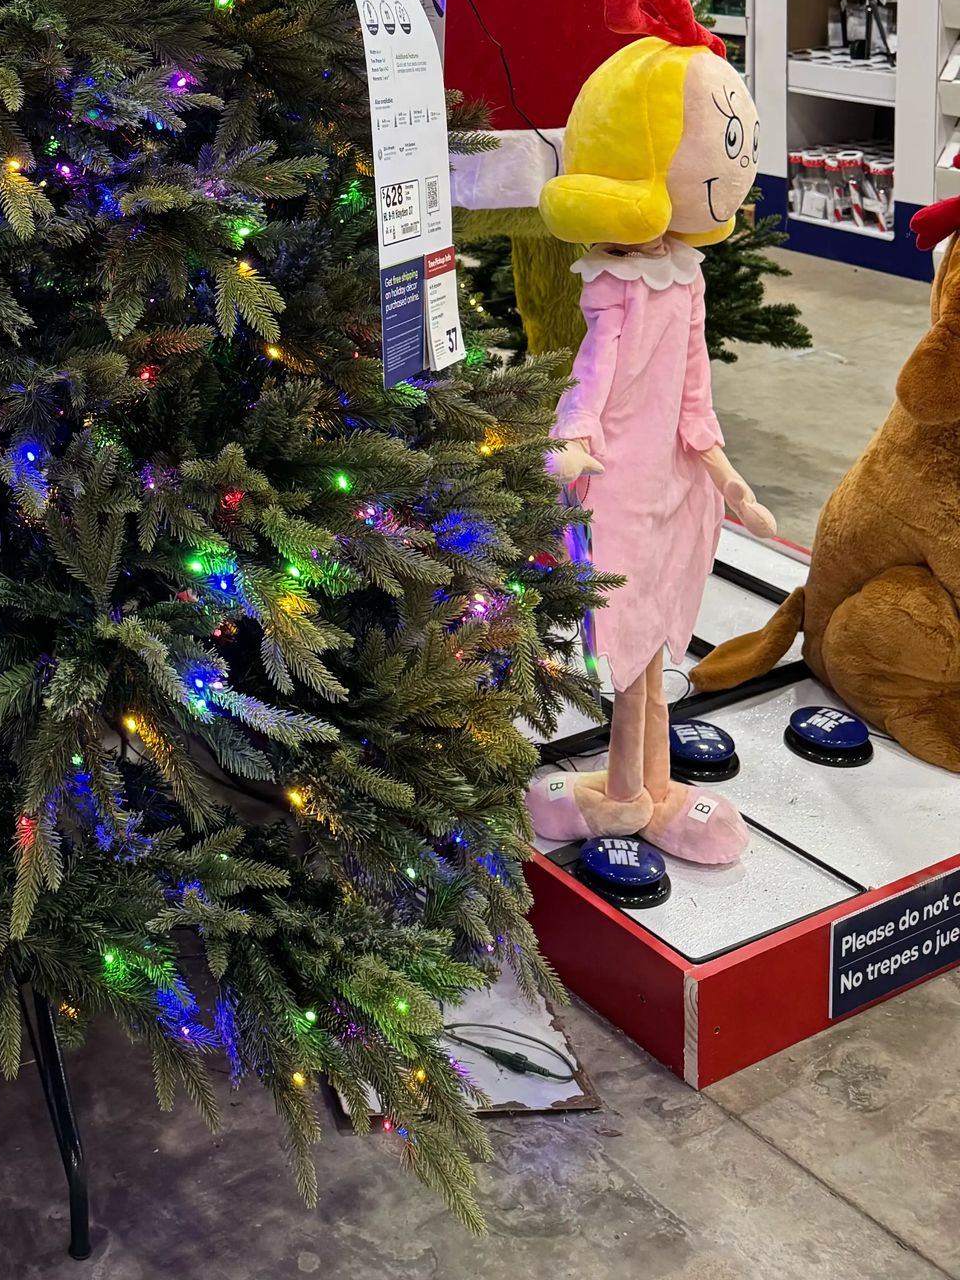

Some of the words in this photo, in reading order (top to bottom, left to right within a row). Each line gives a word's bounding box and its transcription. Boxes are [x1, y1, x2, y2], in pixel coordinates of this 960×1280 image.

[384, 277, 393, 288] Get
[392, 275, 401, 286] free
[401, 270, 418, 284] shipping
[391, 286, 405, 299] holiday
[385, 297, 407, 314] purchased
[446, 327, 458, 353] 37
[806, 712, 840, 733] ME
[816, 707, 855, 723] TRY
[672, 723, 691, 745] TRY
[549, 781, 564, 793] B
[694, 802, 711, 814] B
[599, 838, 641, 851] TRY
[608, 850, 641, 867] ME
[842, 921, 895, 957] Please
[898, 909, 919, 931] do
[923, 894, 949, 920] not
[840, 970, 863, 994] No
[866, 945, 919, 981] trepes
[922, 940, 932, 955] o
